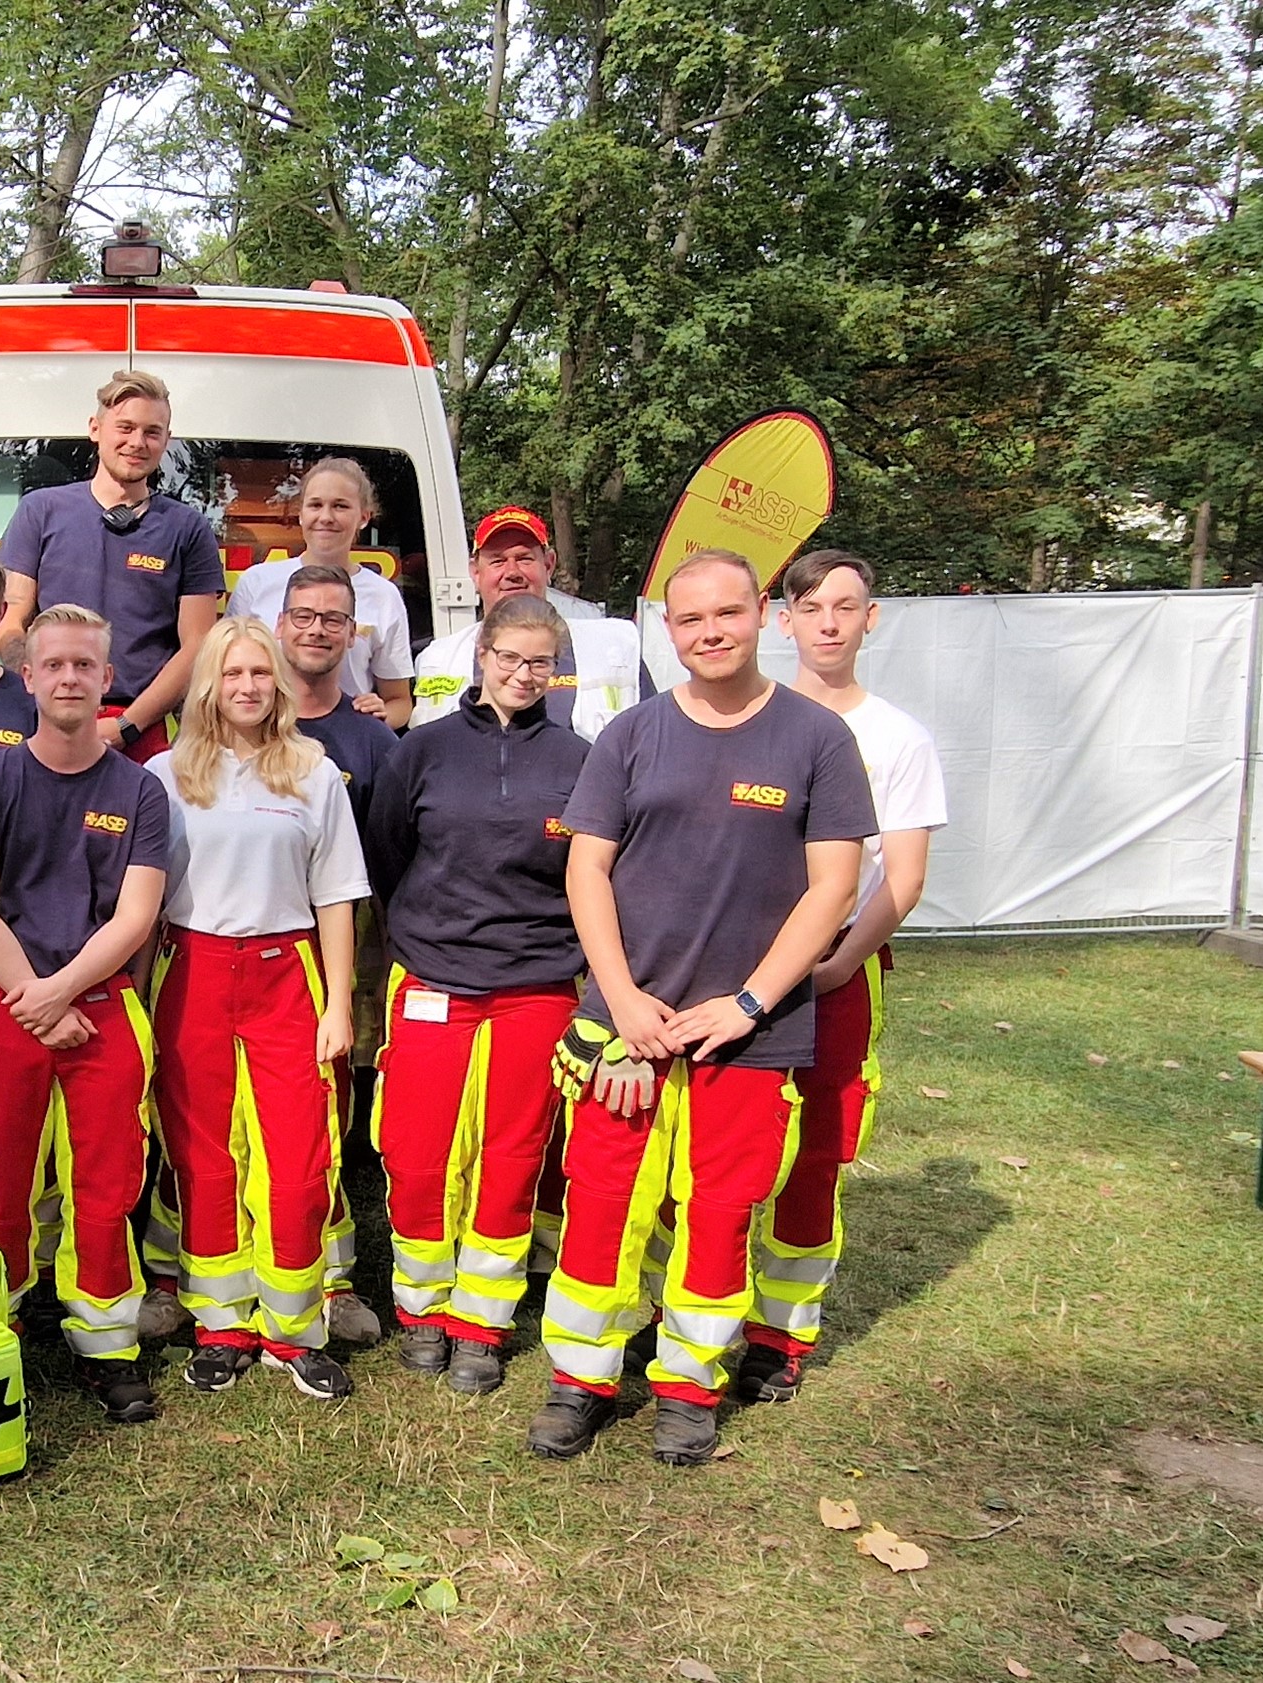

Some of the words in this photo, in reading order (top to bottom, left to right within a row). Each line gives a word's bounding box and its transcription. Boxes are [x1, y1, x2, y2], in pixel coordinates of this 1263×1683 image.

[738, 488, 796, 531] ASB
[138, 555, 166, 570] ASB
[743, 785, 787, 806] ASB
[93, 814, 128, 832] ASB
